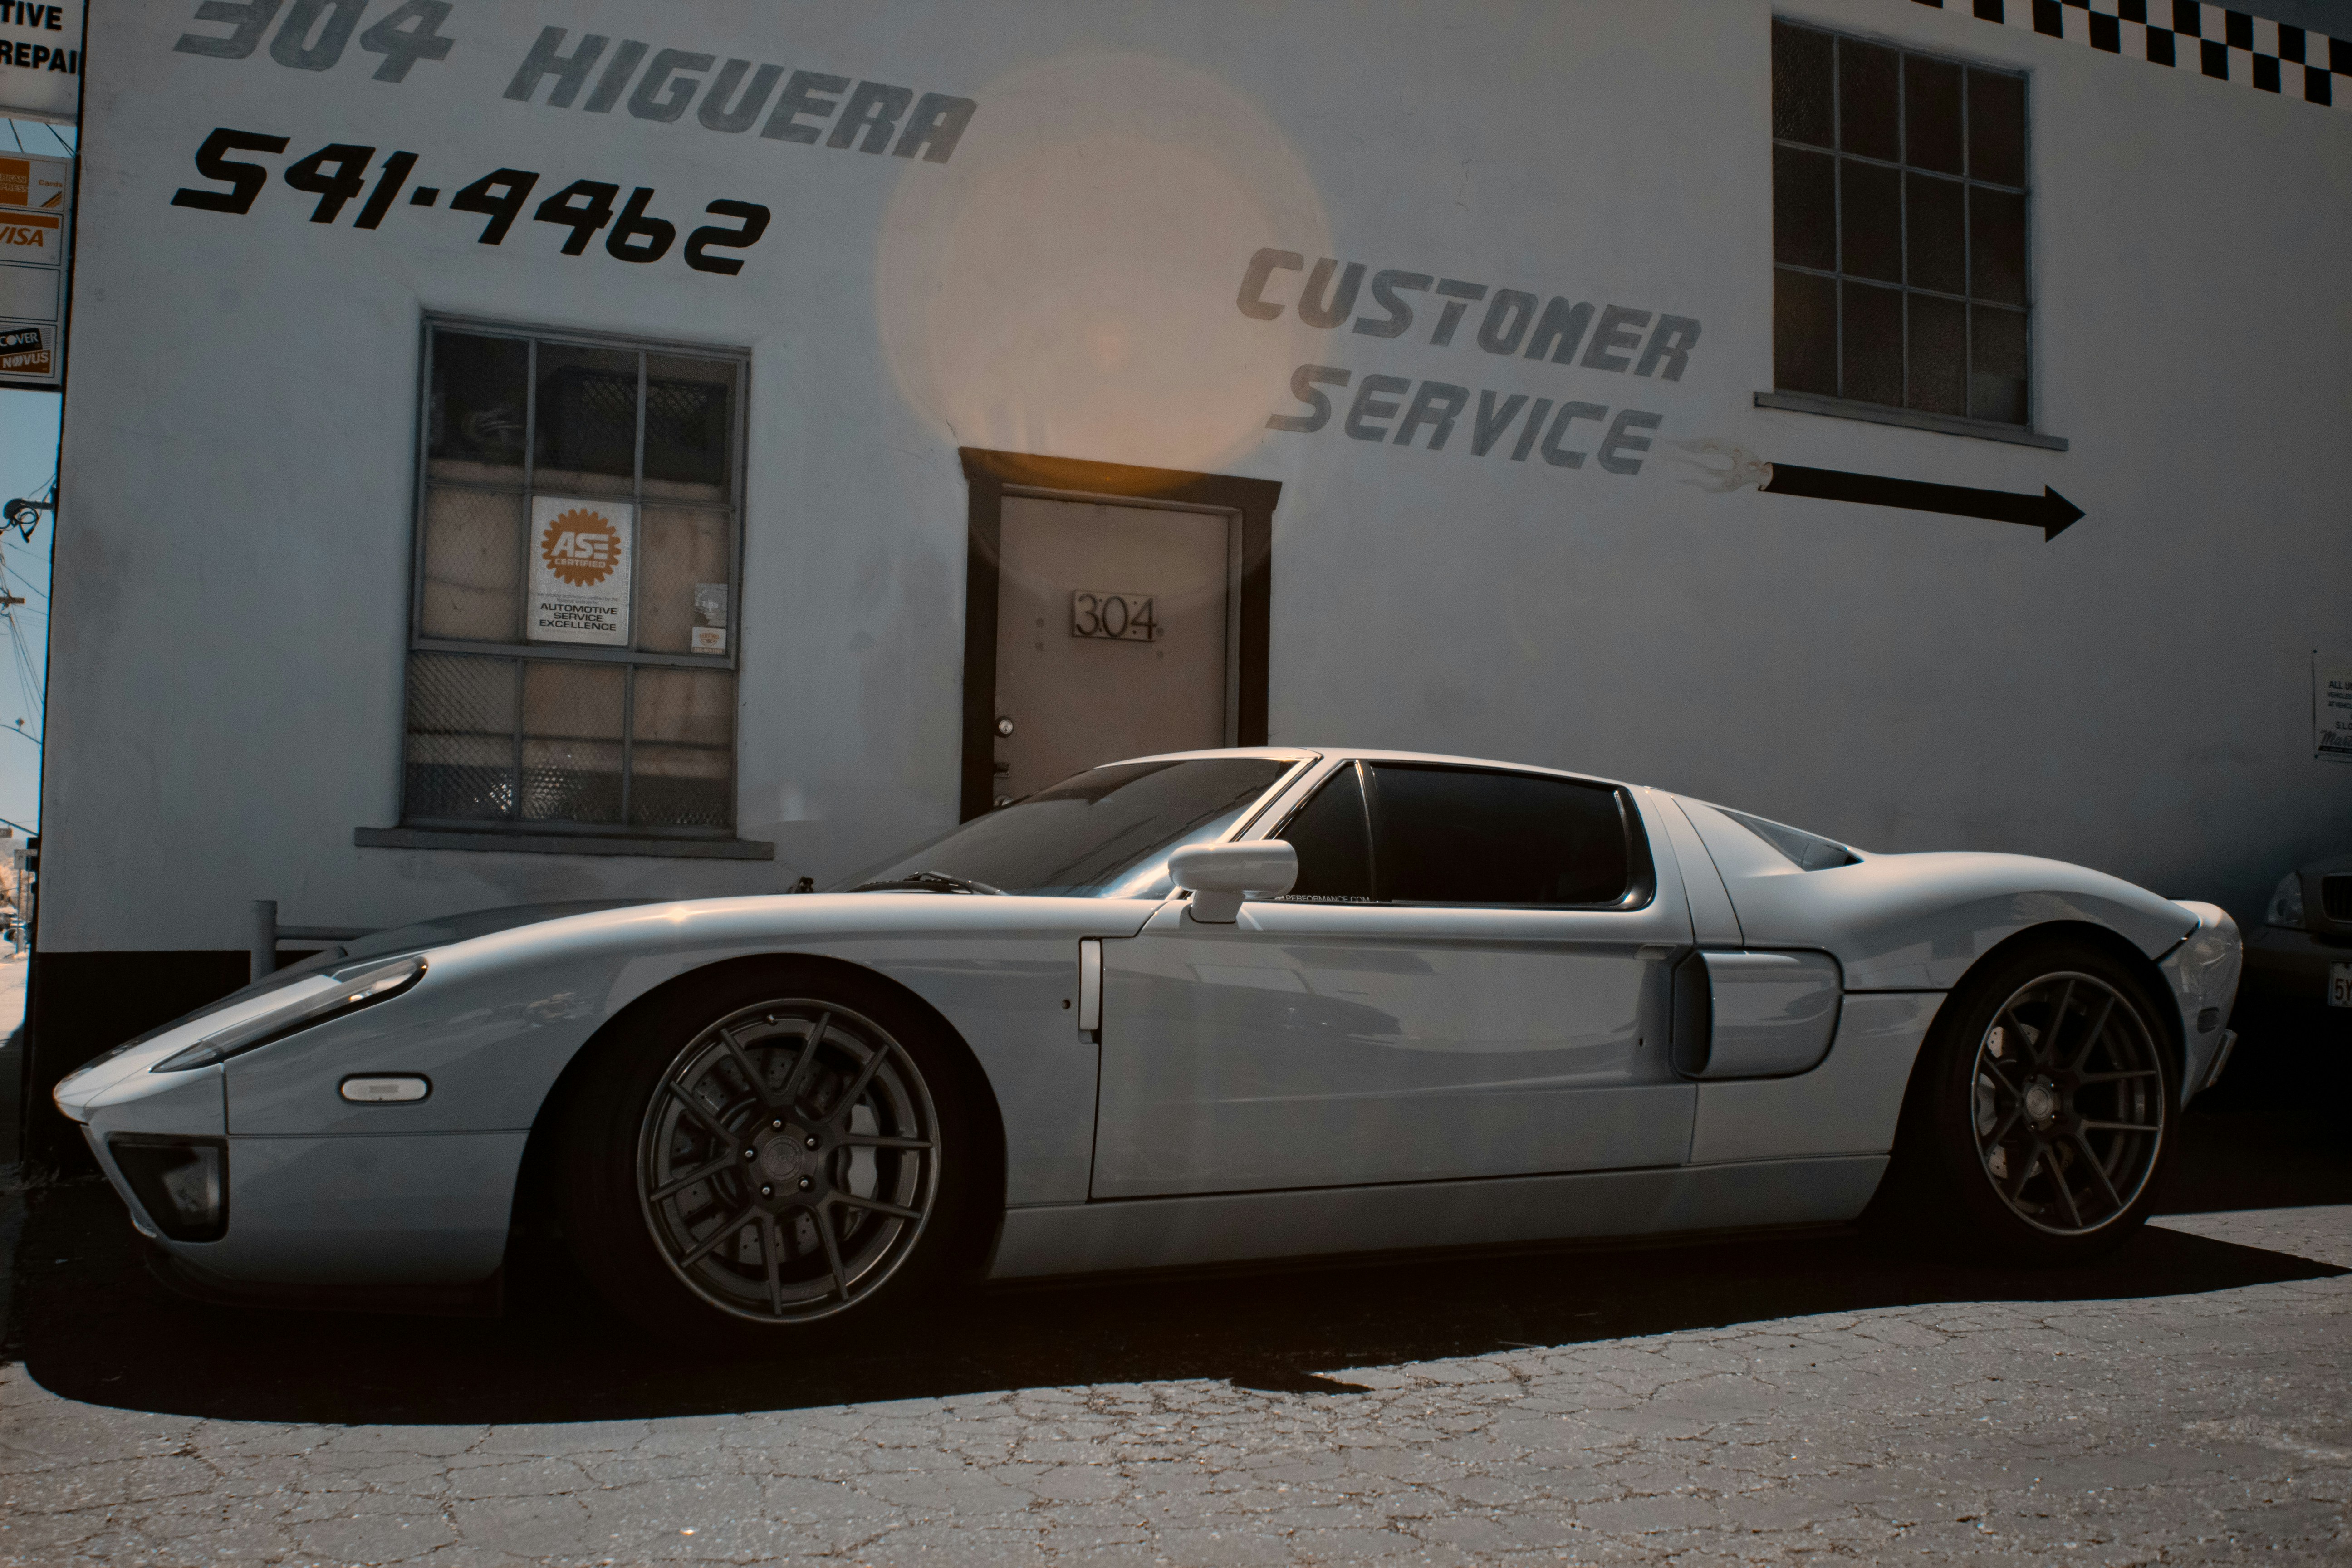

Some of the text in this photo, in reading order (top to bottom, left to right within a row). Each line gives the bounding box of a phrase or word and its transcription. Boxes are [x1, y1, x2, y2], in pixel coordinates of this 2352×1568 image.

[0, 0, 63, 30] TIVE
[0, 39, 77, 75] REPAI
[172, 0, 977, 164] 304 HIGUERA
[39, 179, 63, 187] Cards
[1236, 247, 1701, 382] CUSTOMER
[3, 352, 49, 368] NOVUS
[1264, 363, 1663, 475] SERVICE
[550, 531, 609, 560] ASE
[554, 558, 606, 568] CERTIFIED
[540, 603, 617, 615] AUTOMOTIVE
[554, 612, 603, 622] SERVICE
[1075, 593, 1158, 640] 304
[539, 619, 616, 631] EXCELLENCE
[2328, 681, 2343, 689] ALL
